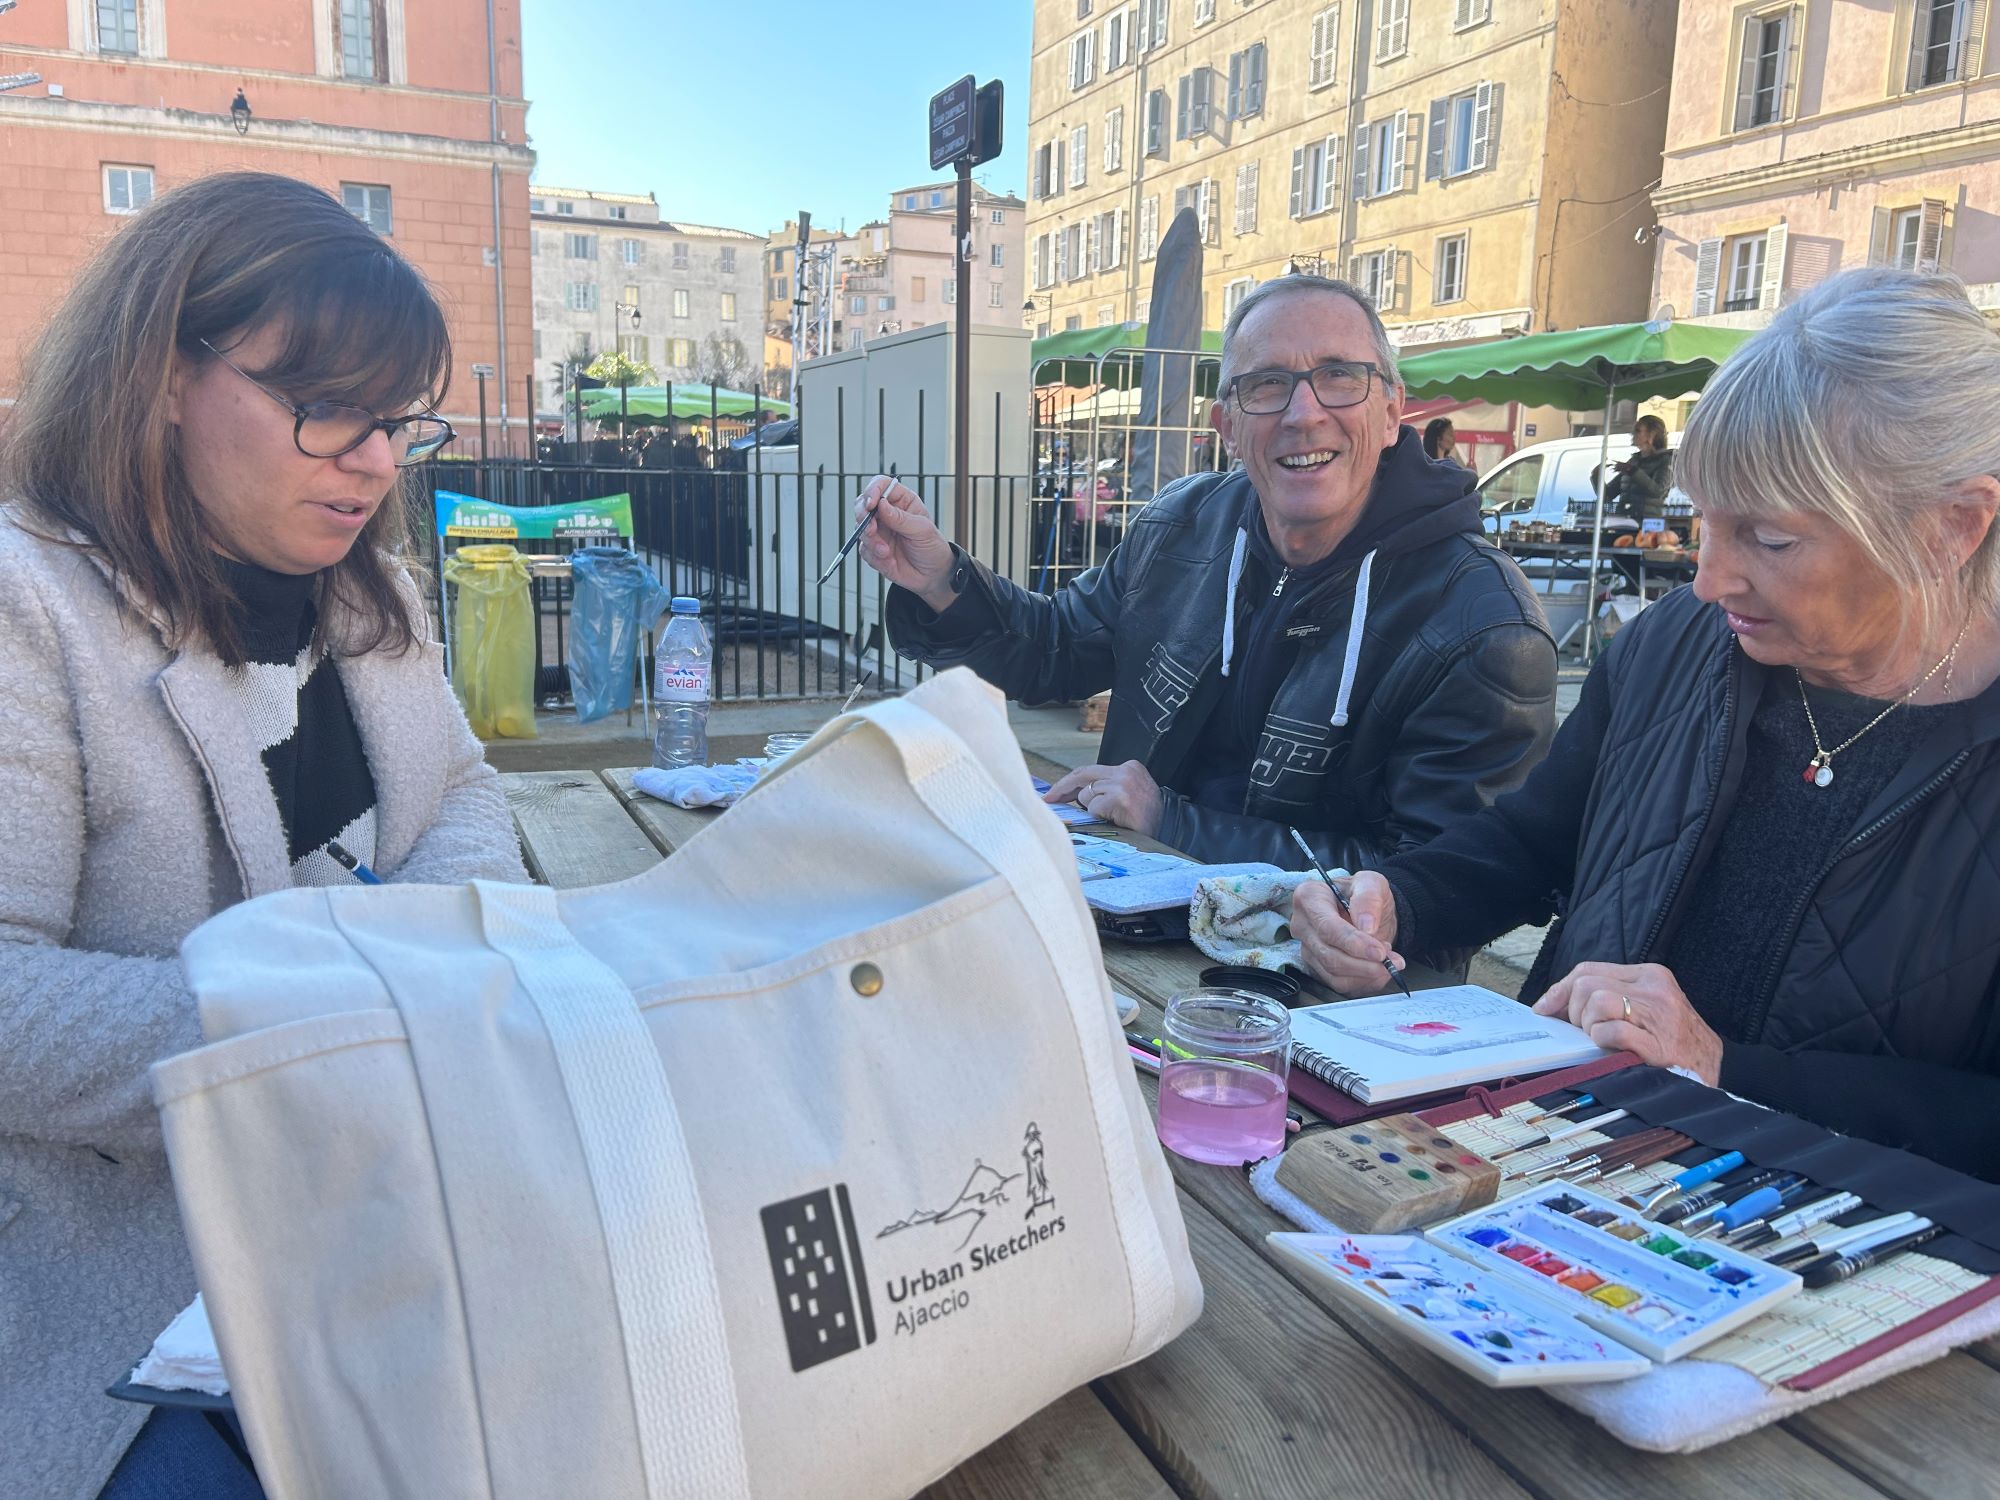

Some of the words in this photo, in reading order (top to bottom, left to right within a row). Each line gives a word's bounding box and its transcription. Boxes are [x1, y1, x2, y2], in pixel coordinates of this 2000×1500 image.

[666, 677, 702, 689] evian
[887, 1261, 964, 1304] Urban
[969, 1215, 1067, 1272] Sketchers
[895, 1289, 970, 1336] Ajaccio
